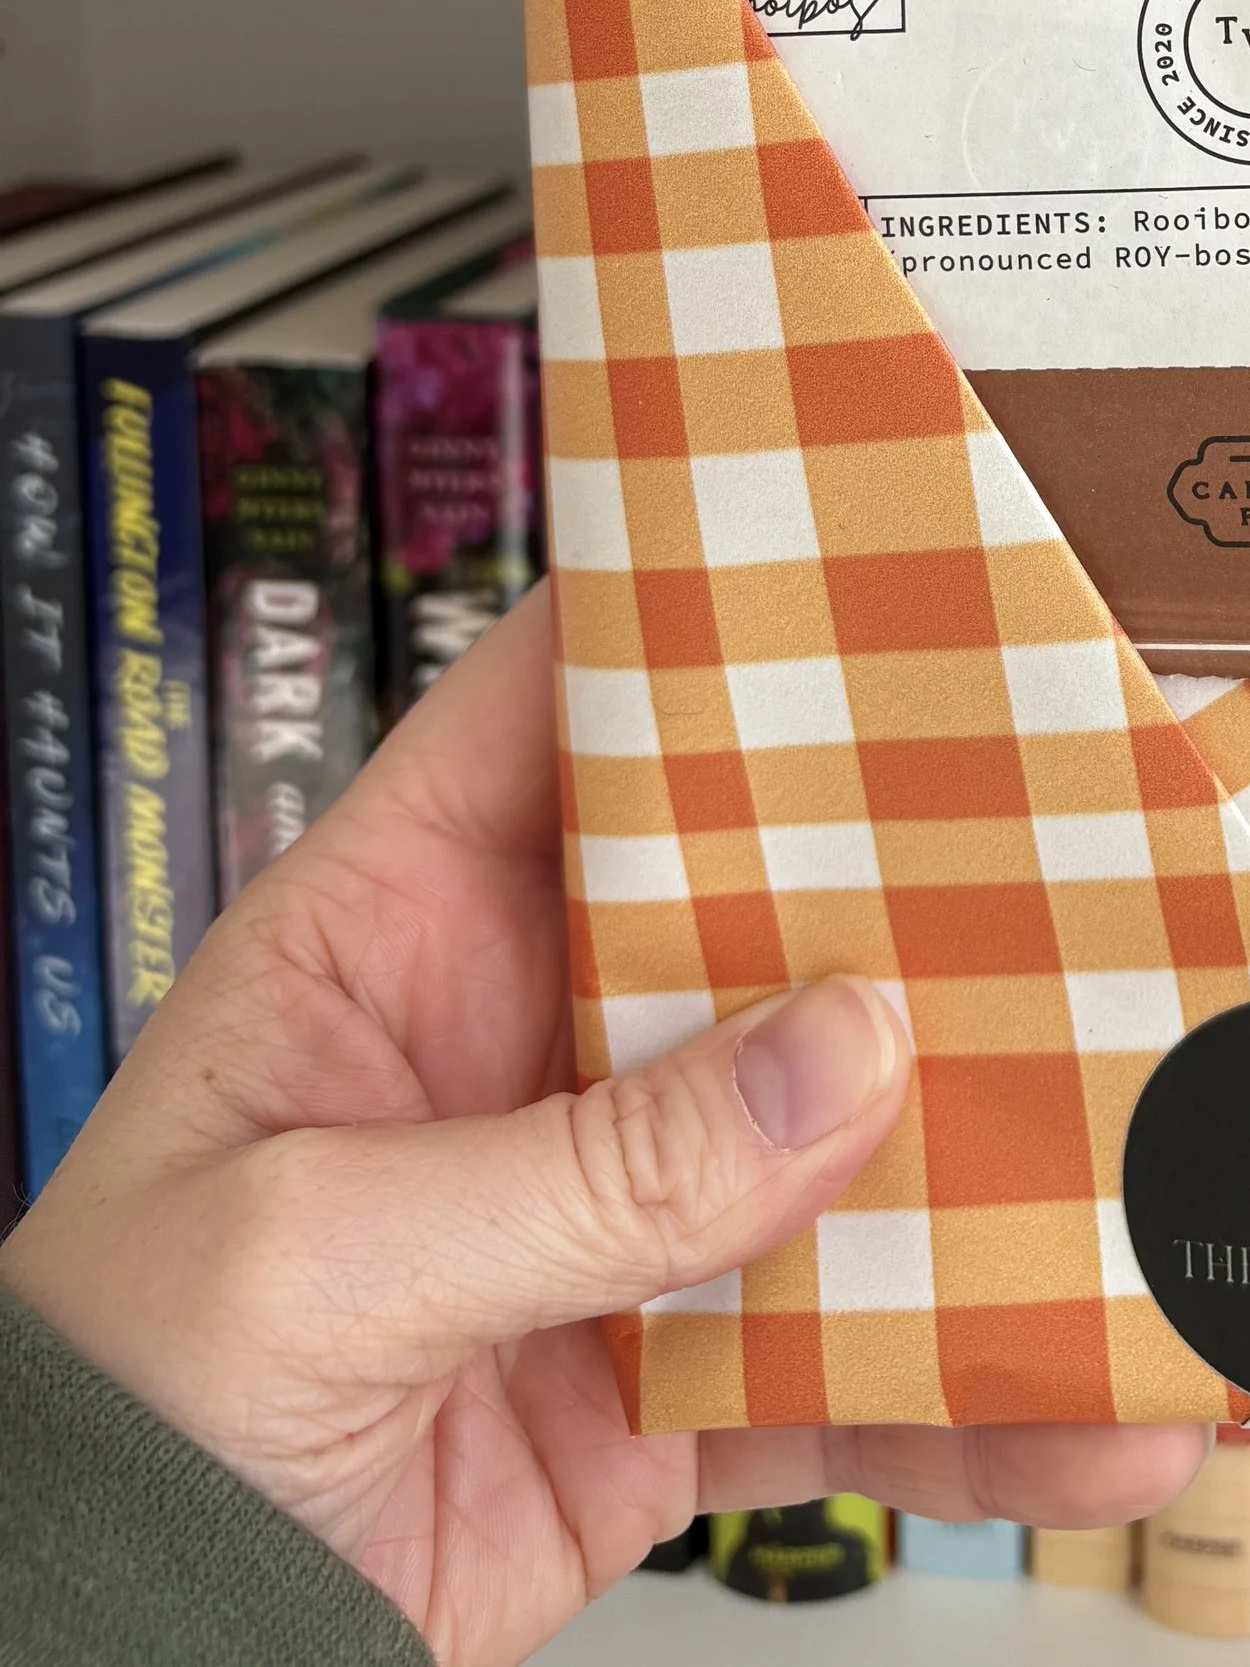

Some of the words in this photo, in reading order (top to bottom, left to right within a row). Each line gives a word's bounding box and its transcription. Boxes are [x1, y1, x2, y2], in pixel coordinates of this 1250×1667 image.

[1154, 22, 1180, 87] 2020
[1176, 96, 1250, 147] SINCE
[881, 211, 1109, 239] INGREDIENTS:
[893, 246, 1093, 279] pronounced
[18, 585, 63, 674] IT
[113, 648, 169, 778] ROAD
[250, 583, 323, 762] DARK
[24, 690, 76, 927] HAUNTS
[123, 783, 176, 1007] MONSTER
[33, 955, 81, 1037] US
